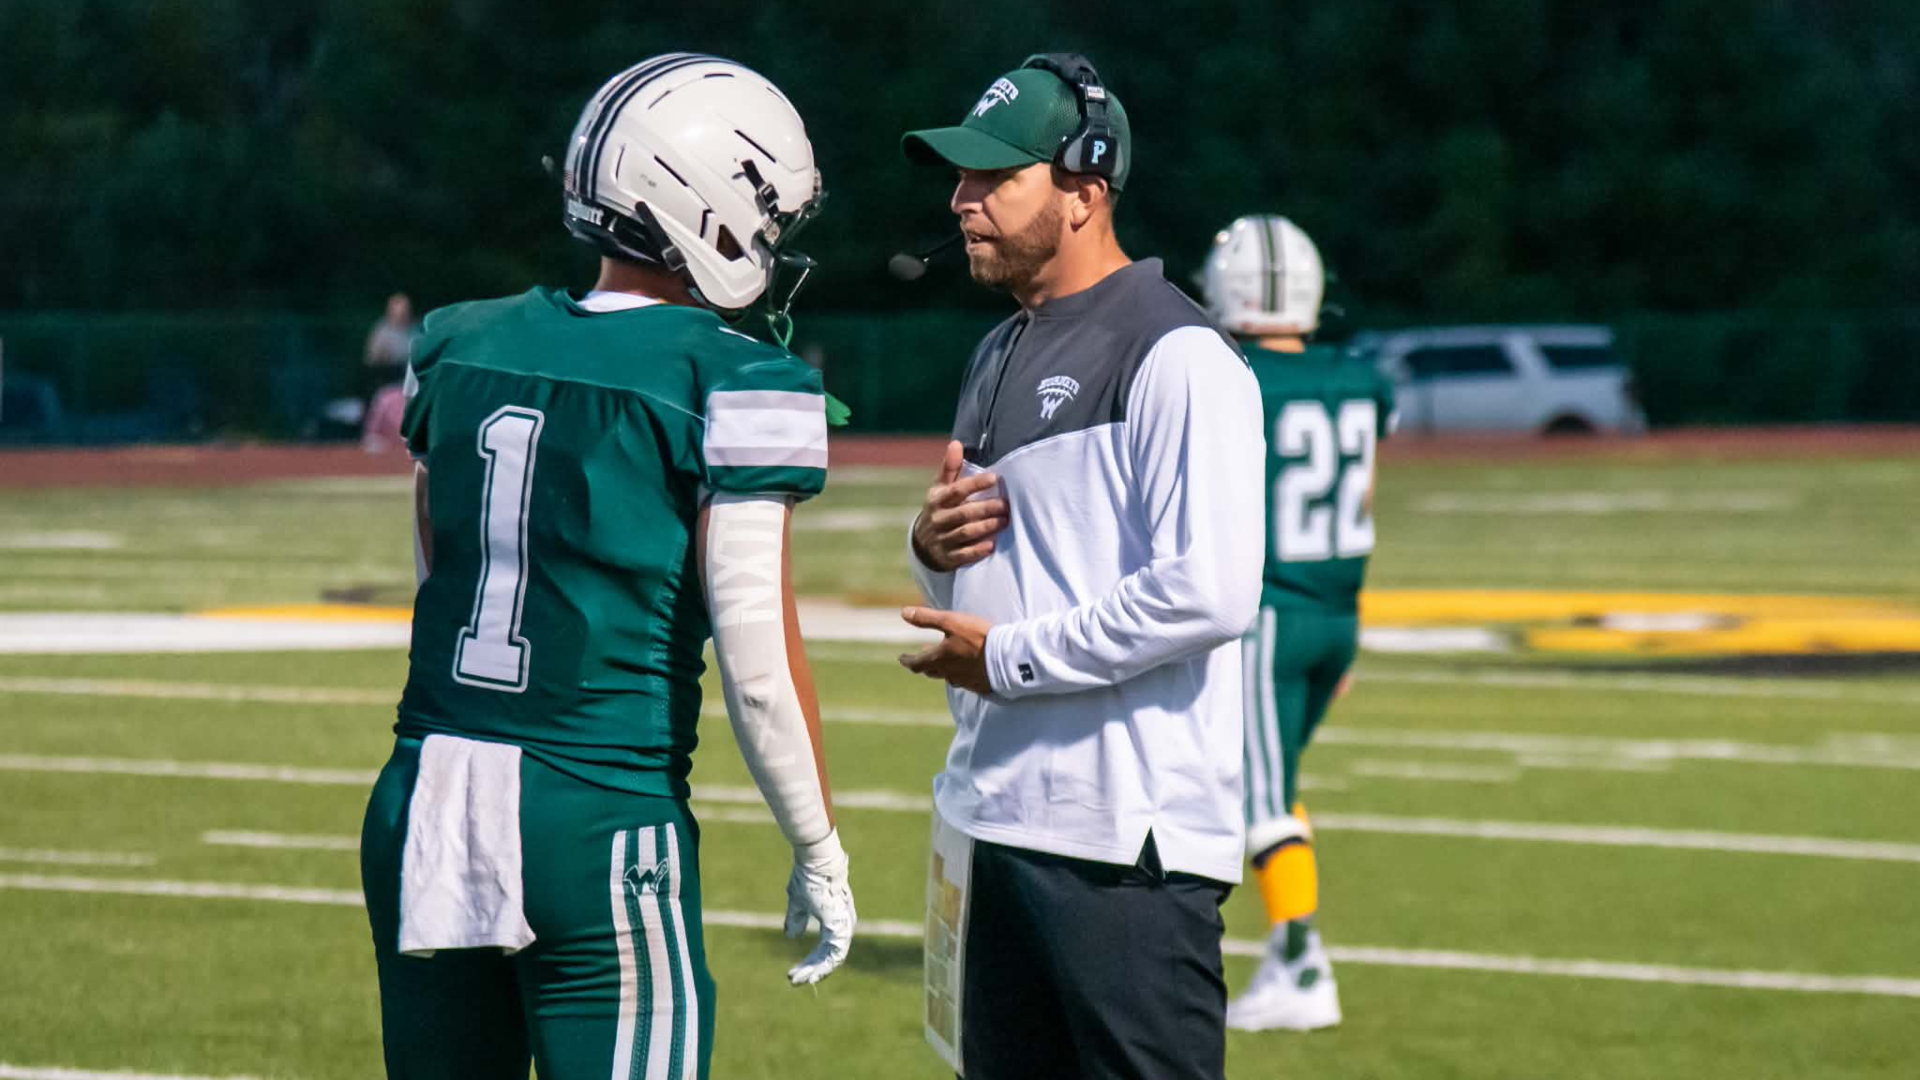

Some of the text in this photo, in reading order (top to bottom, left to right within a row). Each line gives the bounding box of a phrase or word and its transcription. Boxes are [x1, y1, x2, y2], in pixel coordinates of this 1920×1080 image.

[1091, 140, 1107, 164] P
[453, 404, 545, 693] 1
[1274, 399, 1377, 563] 22
